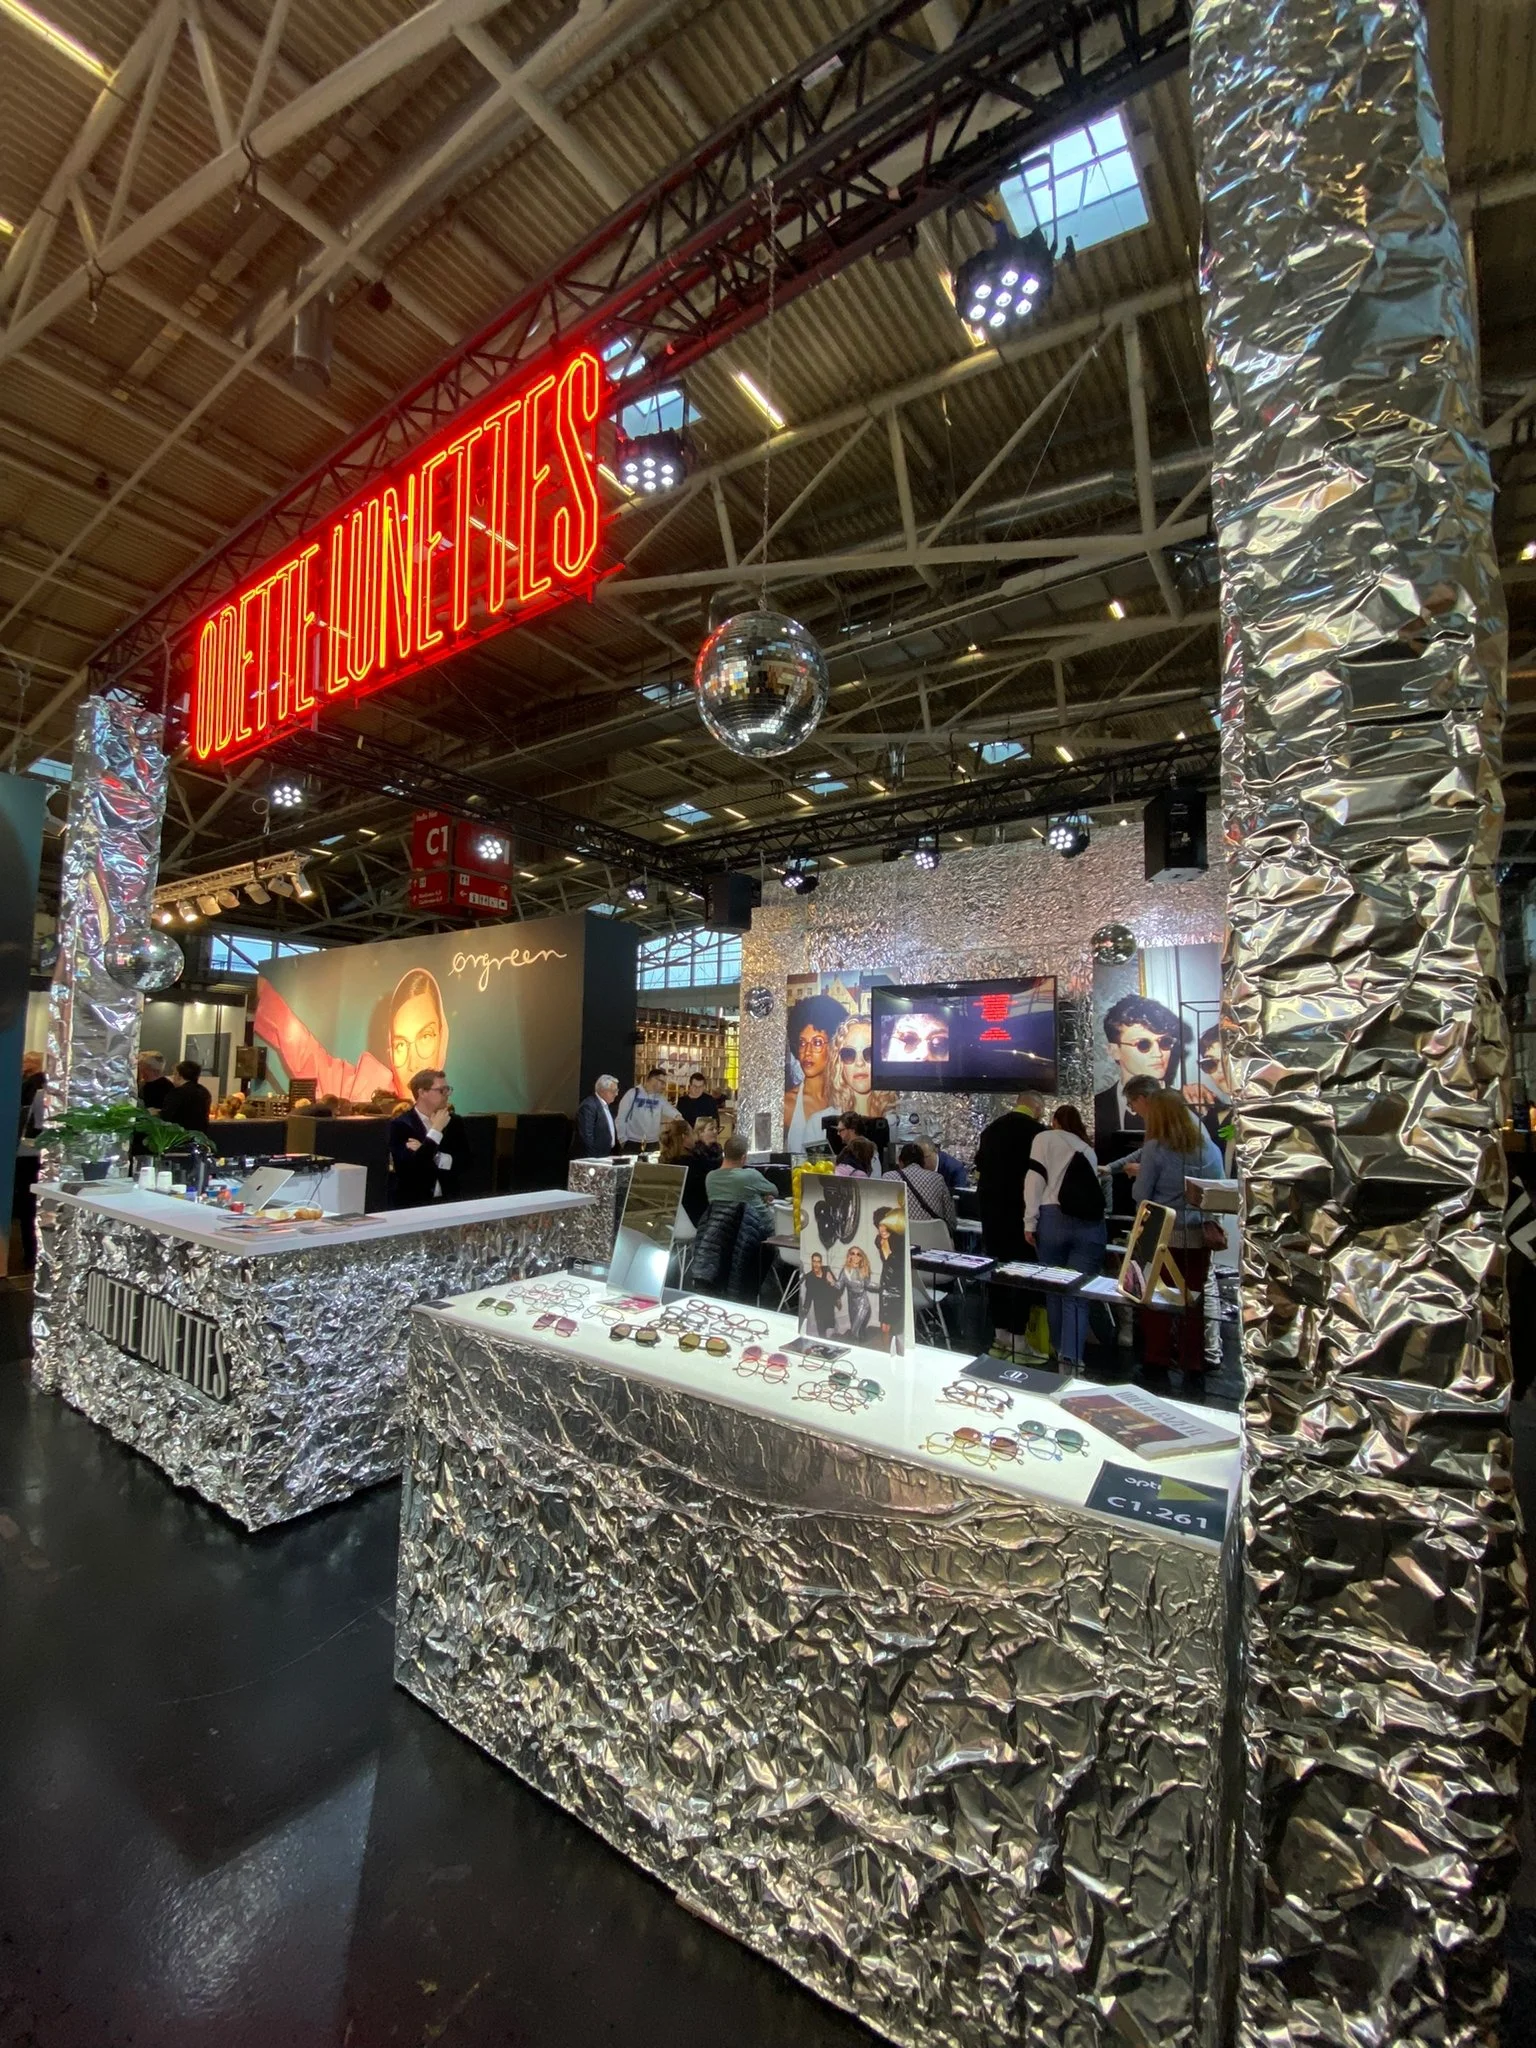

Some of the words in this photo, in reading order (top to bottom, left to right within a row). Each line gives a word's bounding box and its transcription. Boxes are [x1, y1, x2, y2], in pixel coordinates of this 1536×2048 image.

[195, 543, 320, 760] ODETTE
[327, 351, 600, 695] LUNETTES
[426, 825, 449, 855] C1
[448, 948, 568, 992] orgreen
[86, 1270, 141, 1353] ODETTE
[141, 1294, 228, 1400] LUNETTES
[1106, 1495, 1209, 1530] C1.261
